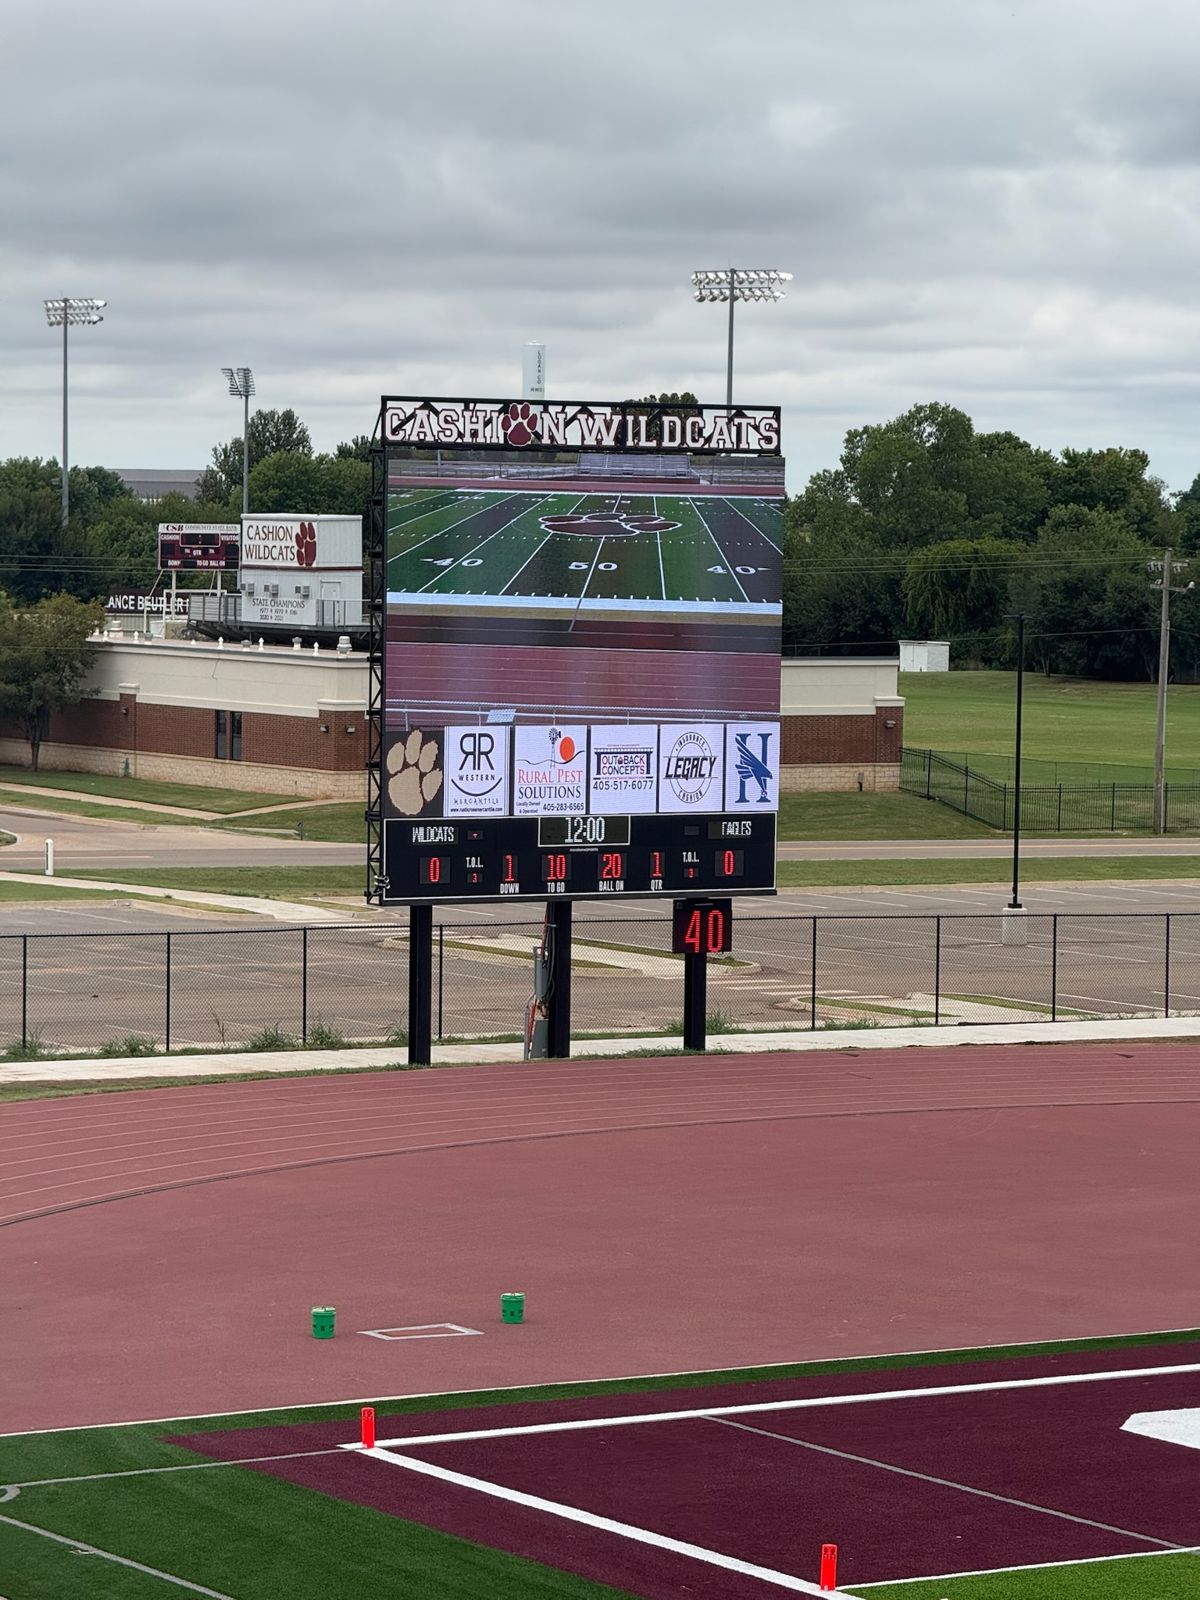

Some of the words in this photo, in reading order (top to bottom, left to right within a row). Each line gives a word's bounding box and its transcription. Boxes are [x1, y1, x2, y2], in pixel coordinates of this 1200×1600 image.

[385, 406, 568, 445] CASHIN
[577, 413, 778, 449] WILDCATS
[246, 524, 293, 541] CASHION
[244, 544, 296, 561] WILDCATS
[105, 594, 135, 610] ANCE
[252, 598, 269, 607] STATE
[270, 600, 306, 608] CHAMPIONS
[518, 769, 552, 784] RURAL
[557, 769, 583, 783] PEST
[601, 765, 645, 775] CONCEPTS
[665, 757, 717, 780] LEGACY
[458, 774, 496, 782] WESTERN
[518, 786, 581, 799] SOLUTIONS
[543, 802, 585, 811] 405-283-6565
[412, 826, 454, 843] WILDCATS
[565, 817, 605, 843] 12:00
[466, 856, 484, 868] T.O.L.
[652, 852, 662, 877] 1
[682, 851, 699, 863] T.O.L.
[723, 850, 734, 875] 0
[429, 857, 440, 882] 0
[504, 855, 515, 881] 1
[547, 854, 566, 880] 10
[602, 853, 621, 879] 20
[472, 873, 477, 883] 3
[599, 881, 614, 892] BALL
[615, 880, 624, 891] ON
[650, 880, 663, 891] QTR
[500, 883, 519, 894] DOWN
[547, 882, 555, 893] TO
[556, 882, 565, 893] GO
[684, 910, 724, 954] 40
